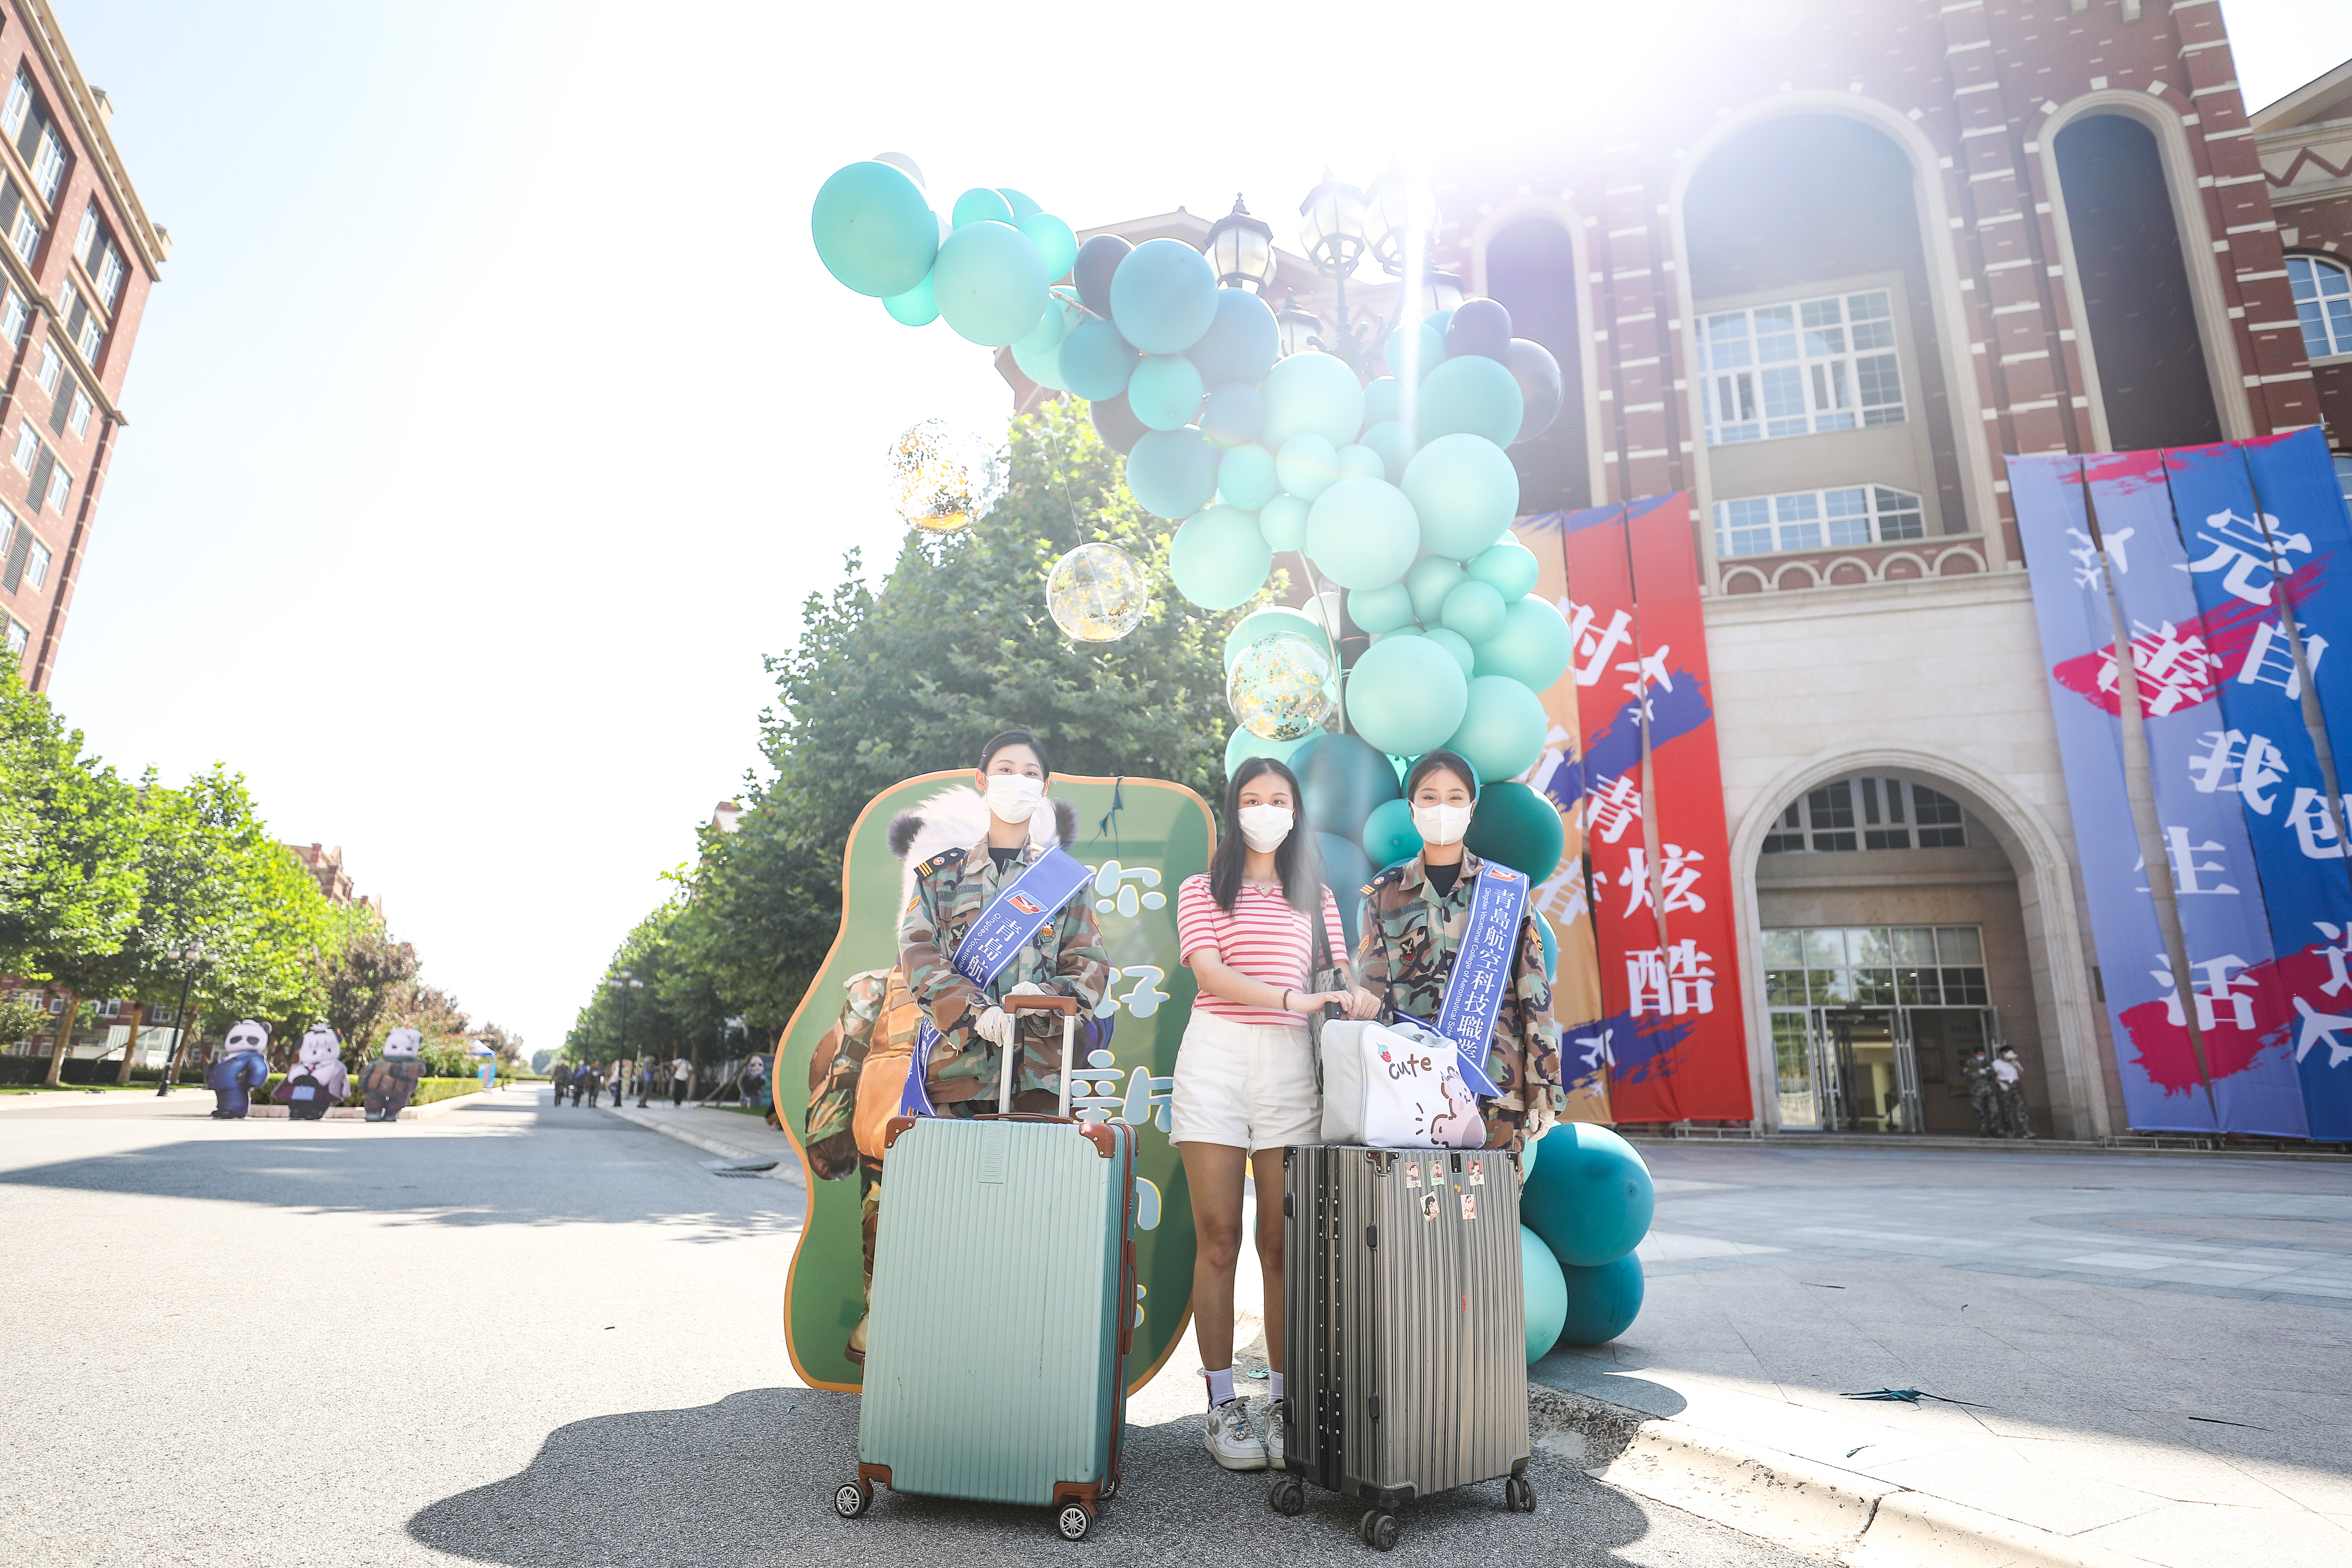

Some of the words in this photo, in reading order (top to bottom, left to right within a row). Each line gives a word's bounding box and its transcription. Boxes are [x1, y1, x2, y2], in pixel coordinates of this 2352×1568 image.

[1482, 887, 1492, 910] Qingdao
[977, 913, 1001, 937] Qingdao
[1474, 910, 1487, 944] Vocational
[1618, 843, 1715, 1017] 炫酷
[2135, 826, 2258, 1030] 生活
[958, 938, 980, 971] Vocational
[1465, 944, 1478, 970] College
[1463, 970, 1470, 979] of
[1450, 979, 1468, 1020] Aeronautical
[1389, 1053, 1432, 1080] cute
